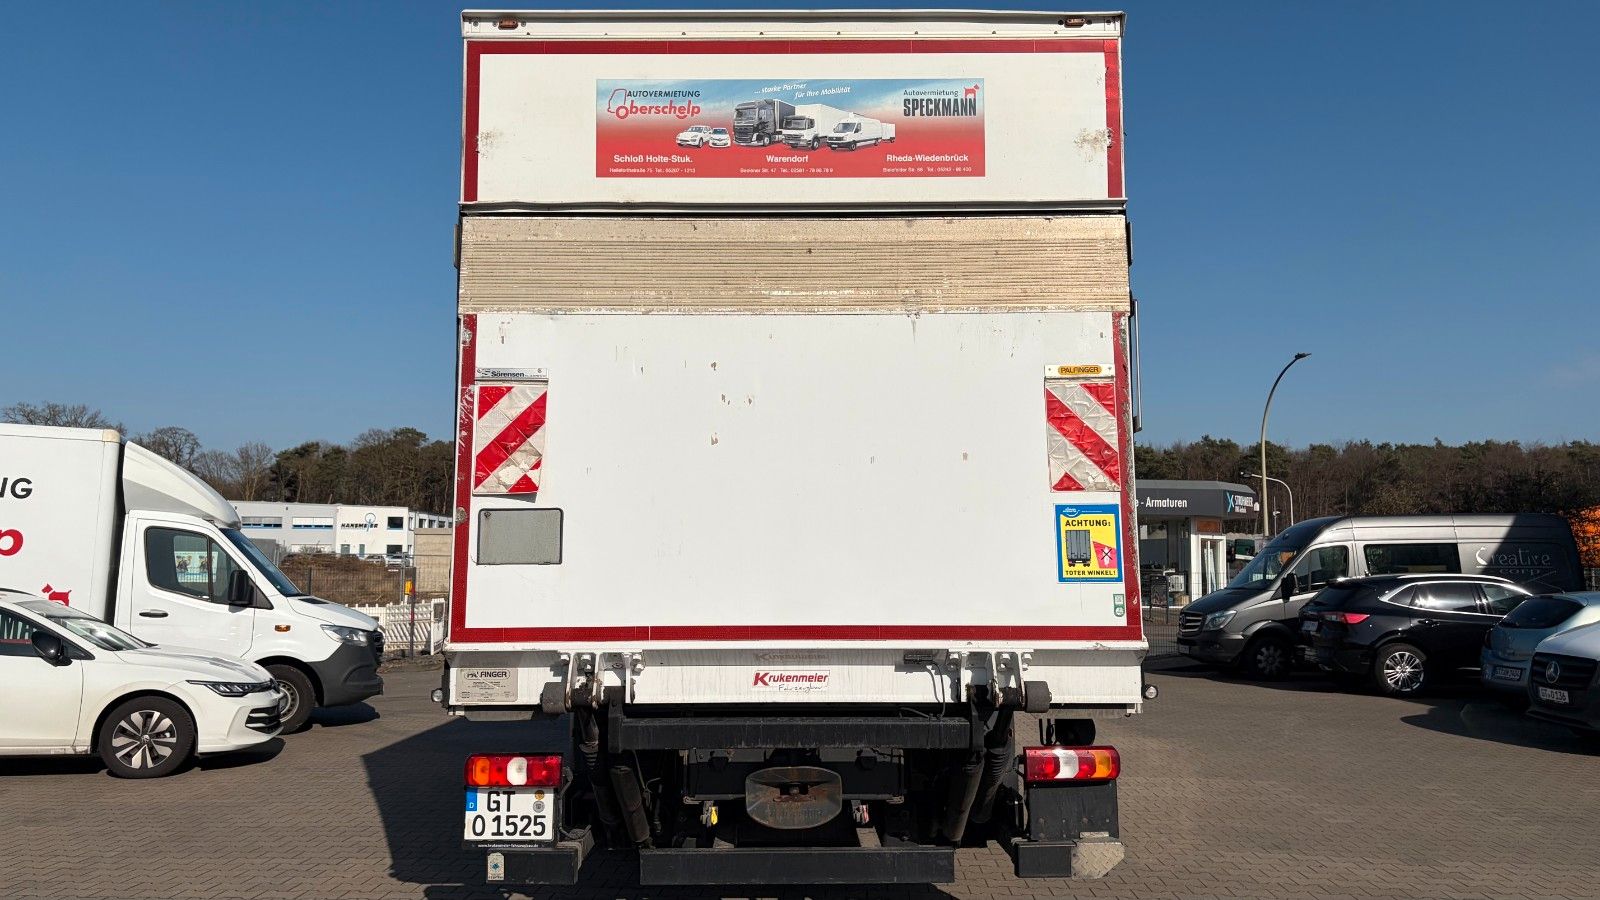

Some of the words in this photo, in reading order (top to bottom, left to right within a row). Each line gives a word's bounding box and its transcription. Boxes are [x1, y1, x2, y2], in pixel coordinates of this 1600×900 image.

[783, 82, 808, 91] Partner
[820, 86, 851, 96] Mobilität
[627, 90, 701, 98] AUTOVERMIETUNG
[903, 89, 959, 97] Autovermietung
[903, 98, 977, 116] SPECKMANN
[613, 154, 644, 163] Schloß
[645, 154, 693, 163] Holte-Stuk.
[765, 154, 809, 163] Warendorf
[886, 153, 969, 162] Rheda-Wiedenbrück
[1060, 366, 1099, 374] PALFINGER
[1146, 497, 1188, 508] Armaturen
[1475, 546, 1552, 567] Creative
[1499, 568, 1541, 576] corp
[753, 672, 829, 687] Krukenmeier
[486, 790, 516, 812] GT
[490, 814, 546, 836] 1525
